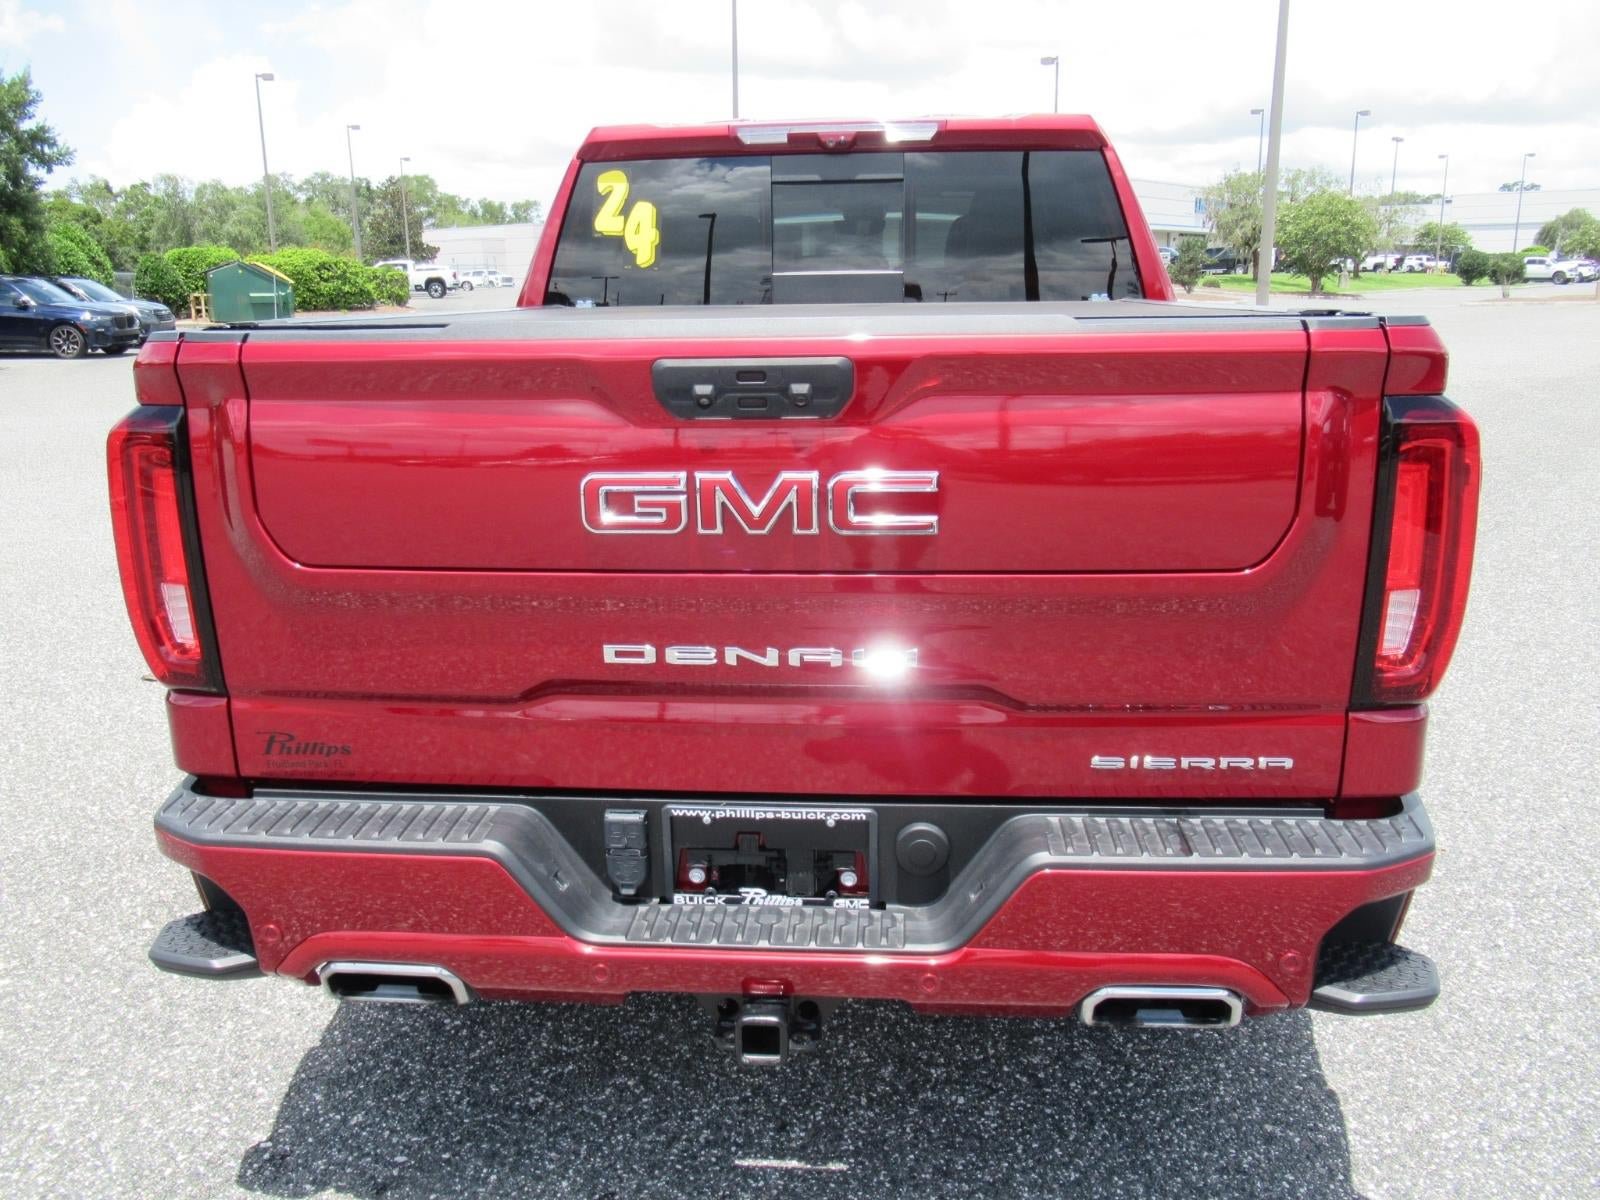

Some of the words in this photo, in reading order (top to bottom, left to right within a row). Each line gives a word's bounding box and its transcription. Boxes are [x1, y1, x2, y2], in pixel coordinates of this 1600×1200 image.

[594, 169, 660, 269] 24
[580, 470, 940, 535] GMC
[256, 730, 352, 757] Phillips
[1090, 754, 1294, 771] SIERRA
[671, 807, 867, 821] www.phillips-buick.com
[673, 893, 727, 906] BUICK
[738, 886, 804, 908] Phillips
[832, 897, 870, 910] GMC
